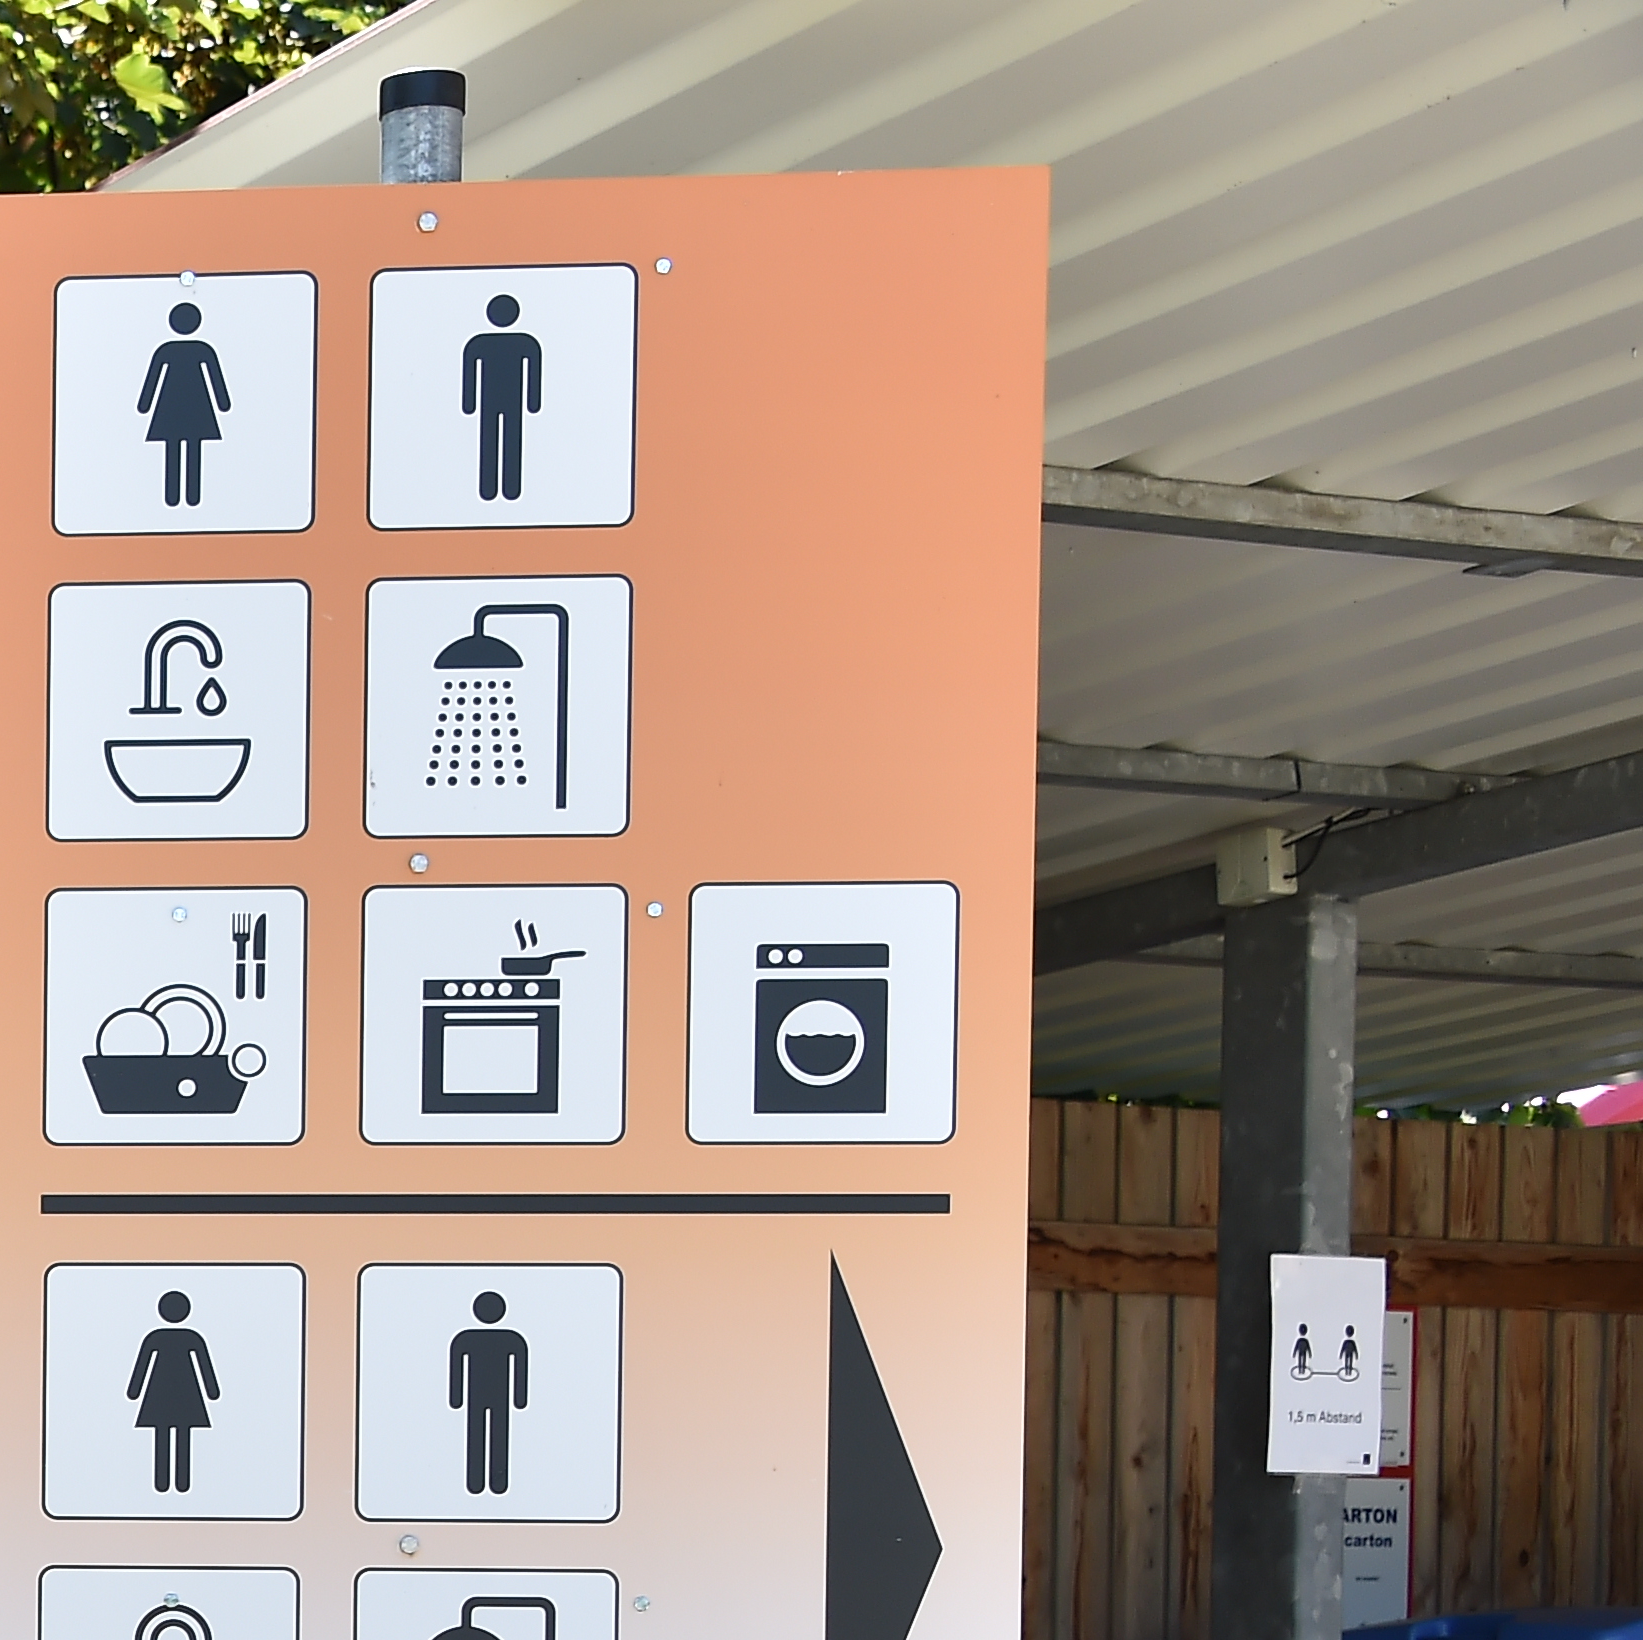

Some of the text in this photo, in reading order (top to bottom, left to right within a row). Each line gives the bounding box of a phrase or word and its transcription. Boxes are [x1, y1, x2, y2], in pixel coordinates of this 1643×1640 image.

[1288, 1410, 1363, 1424] 1,5 m Abstand
[1344, 1534, 1393, 1548] carton
